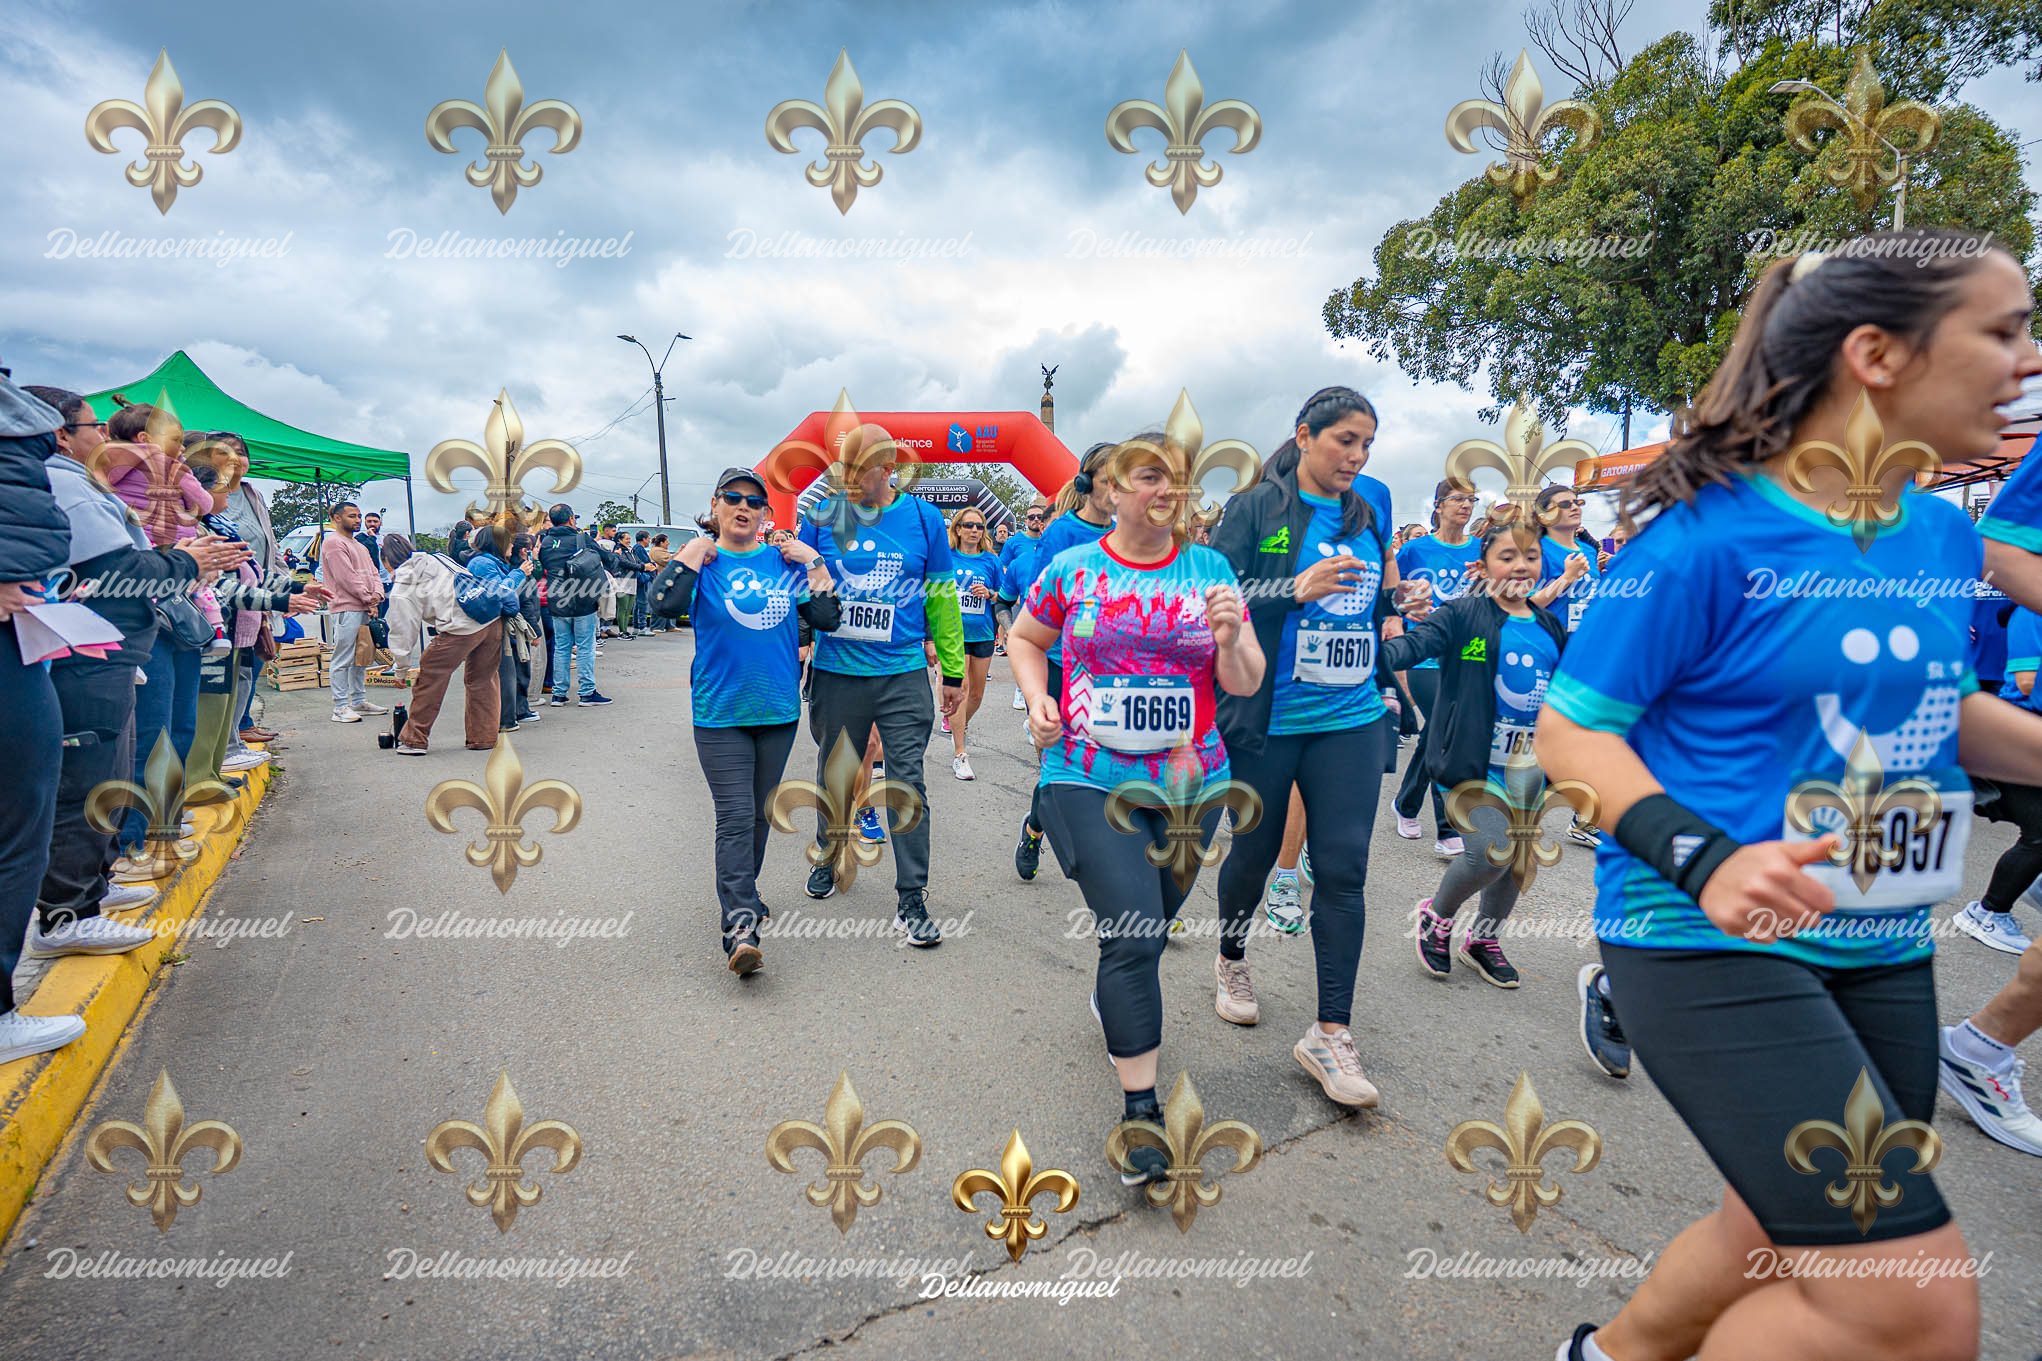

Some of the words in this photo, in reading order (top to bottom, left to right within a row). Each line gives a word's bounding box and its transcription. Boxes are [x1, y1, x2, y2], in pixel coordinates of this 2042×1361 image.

[976, 425, 998, 438] AAU
[894, 437, 933, 448] alance
[936, 494, 969, 502] LEJOS
[961, 595, 982, 609] 15791
[848, 605, 891, 631] 16648
[1326, 638, 1371, 668] 16670
[1121, 695, 1191, 732] 16669
[1504, 730, 1535, 756] 166
